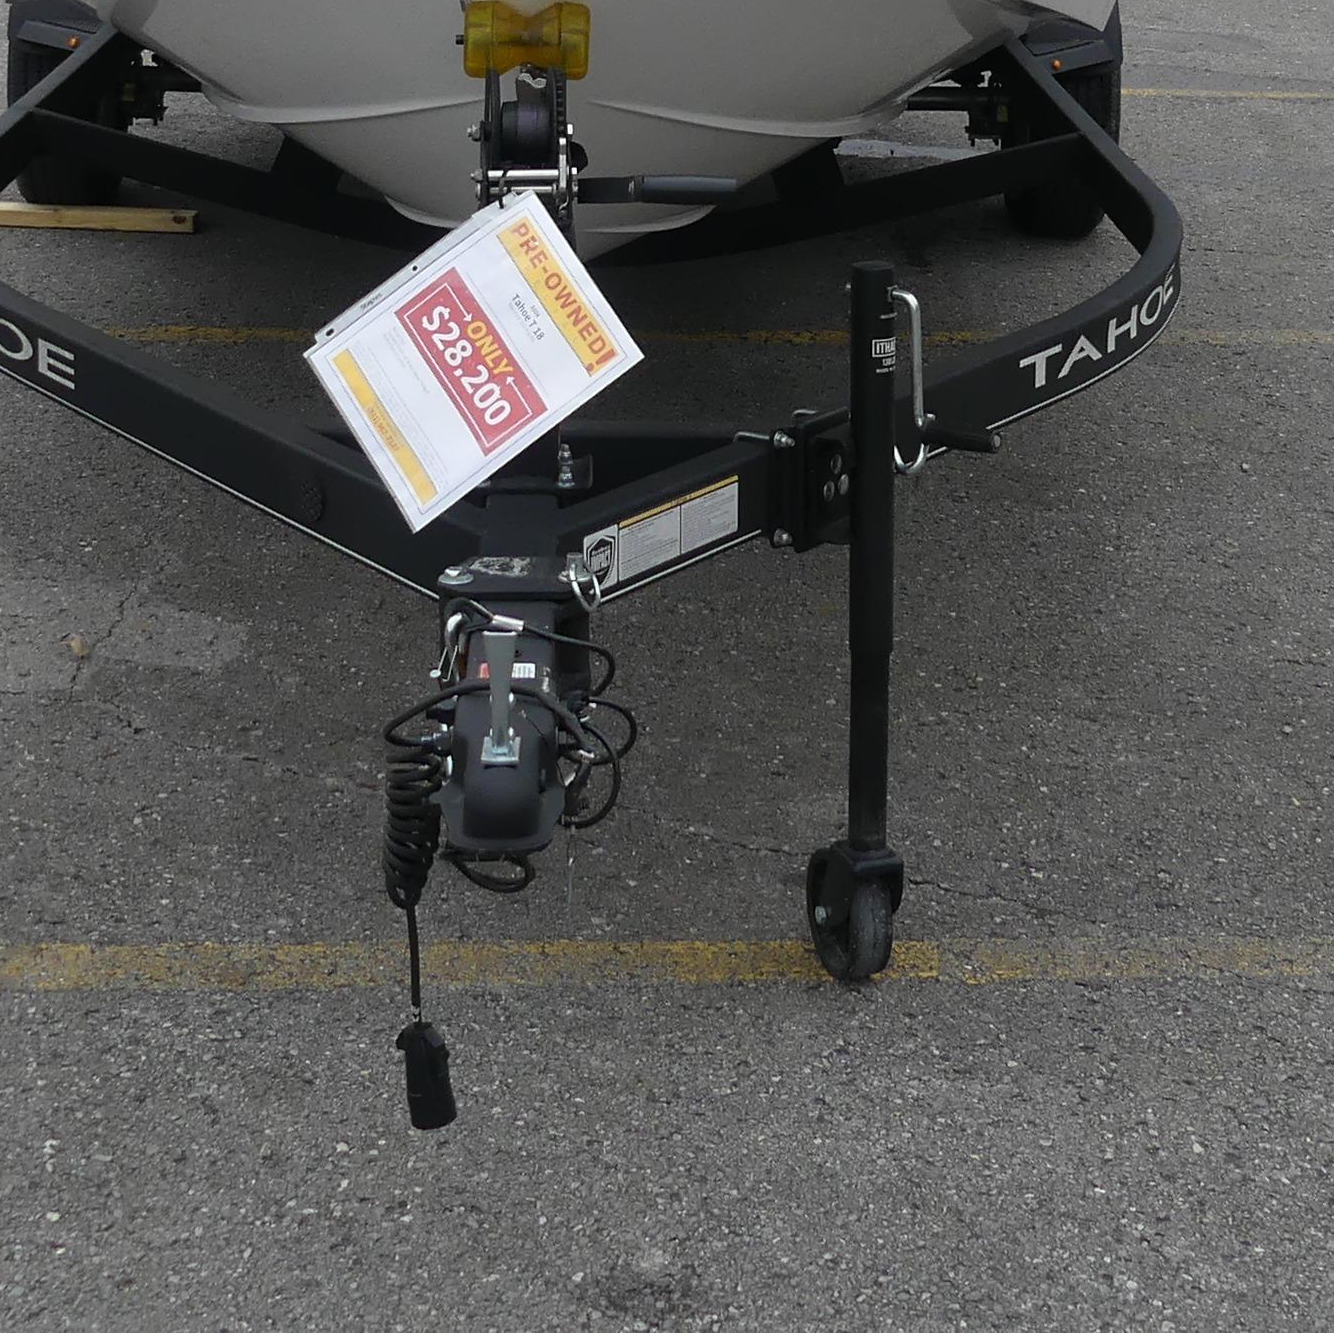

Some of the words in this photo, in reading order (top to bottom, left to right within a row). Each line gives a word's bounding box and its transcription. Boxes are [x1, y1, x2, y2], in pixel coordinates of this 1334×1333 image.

[512, 222, 617, 372] PRE-OWNED!
[512, 294, 531, 322] Tahoe
[533, 328, 545, 340] 18
[421, 306, 511, 425] $28,200
[467, 321, 513, 378] ONLY
